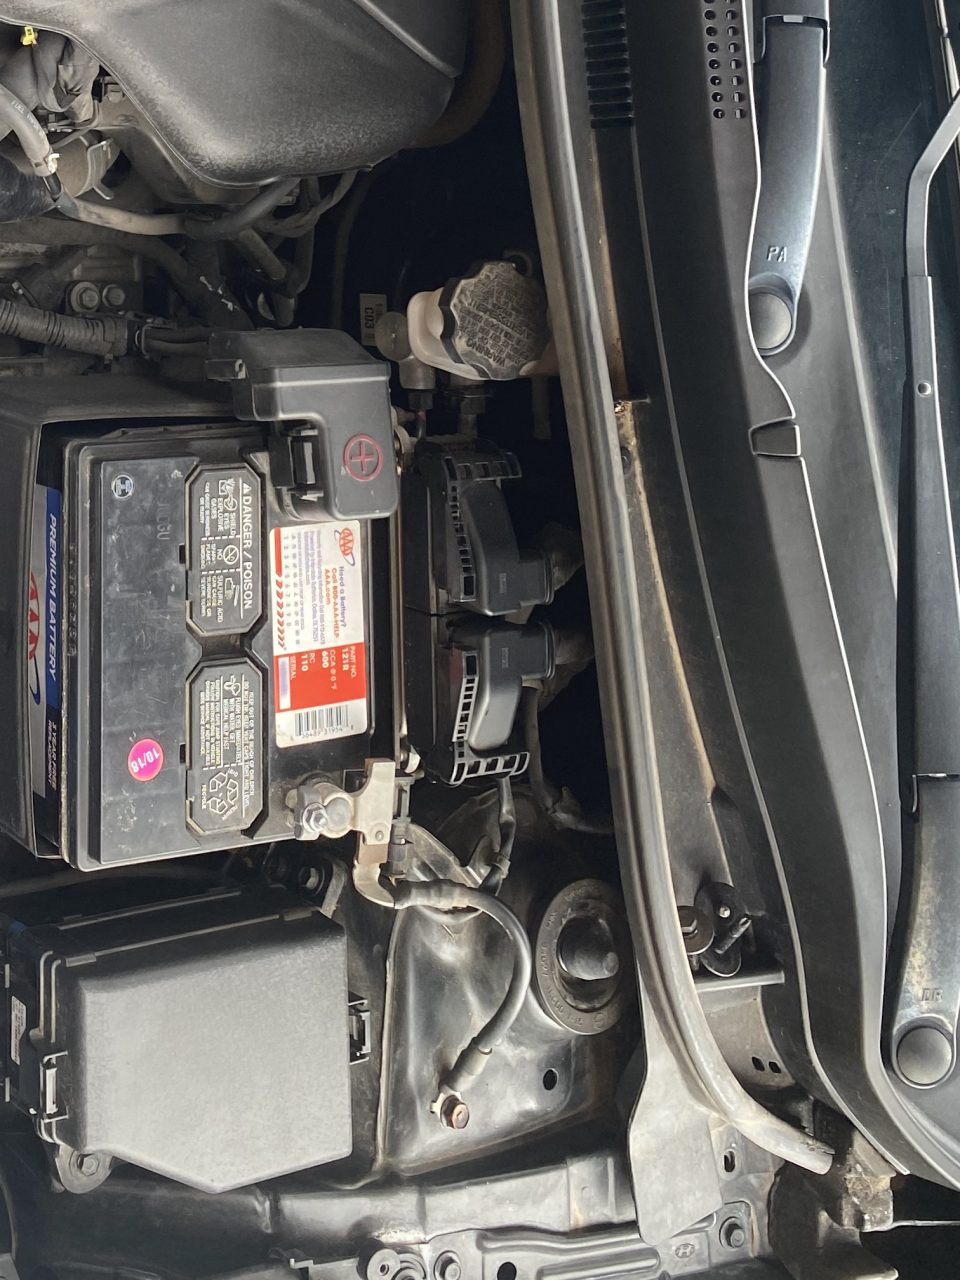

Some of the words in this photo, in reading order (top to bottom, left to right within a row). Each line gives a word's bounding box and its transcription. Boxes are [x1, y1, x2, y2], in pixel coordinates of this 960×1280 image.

[767, 245, 787, 262] PA
[243, 496, 251, 548] DANGER
[48, 513, 57, 600] PREMIUM
[217, 549, 222, 560] NO
[244, 562, 253, 608] POISON
[48, 602, 57, 682] BATTERY
[310, 653, 315, 663] RC
[130, 747, 160, 772] 10/18
